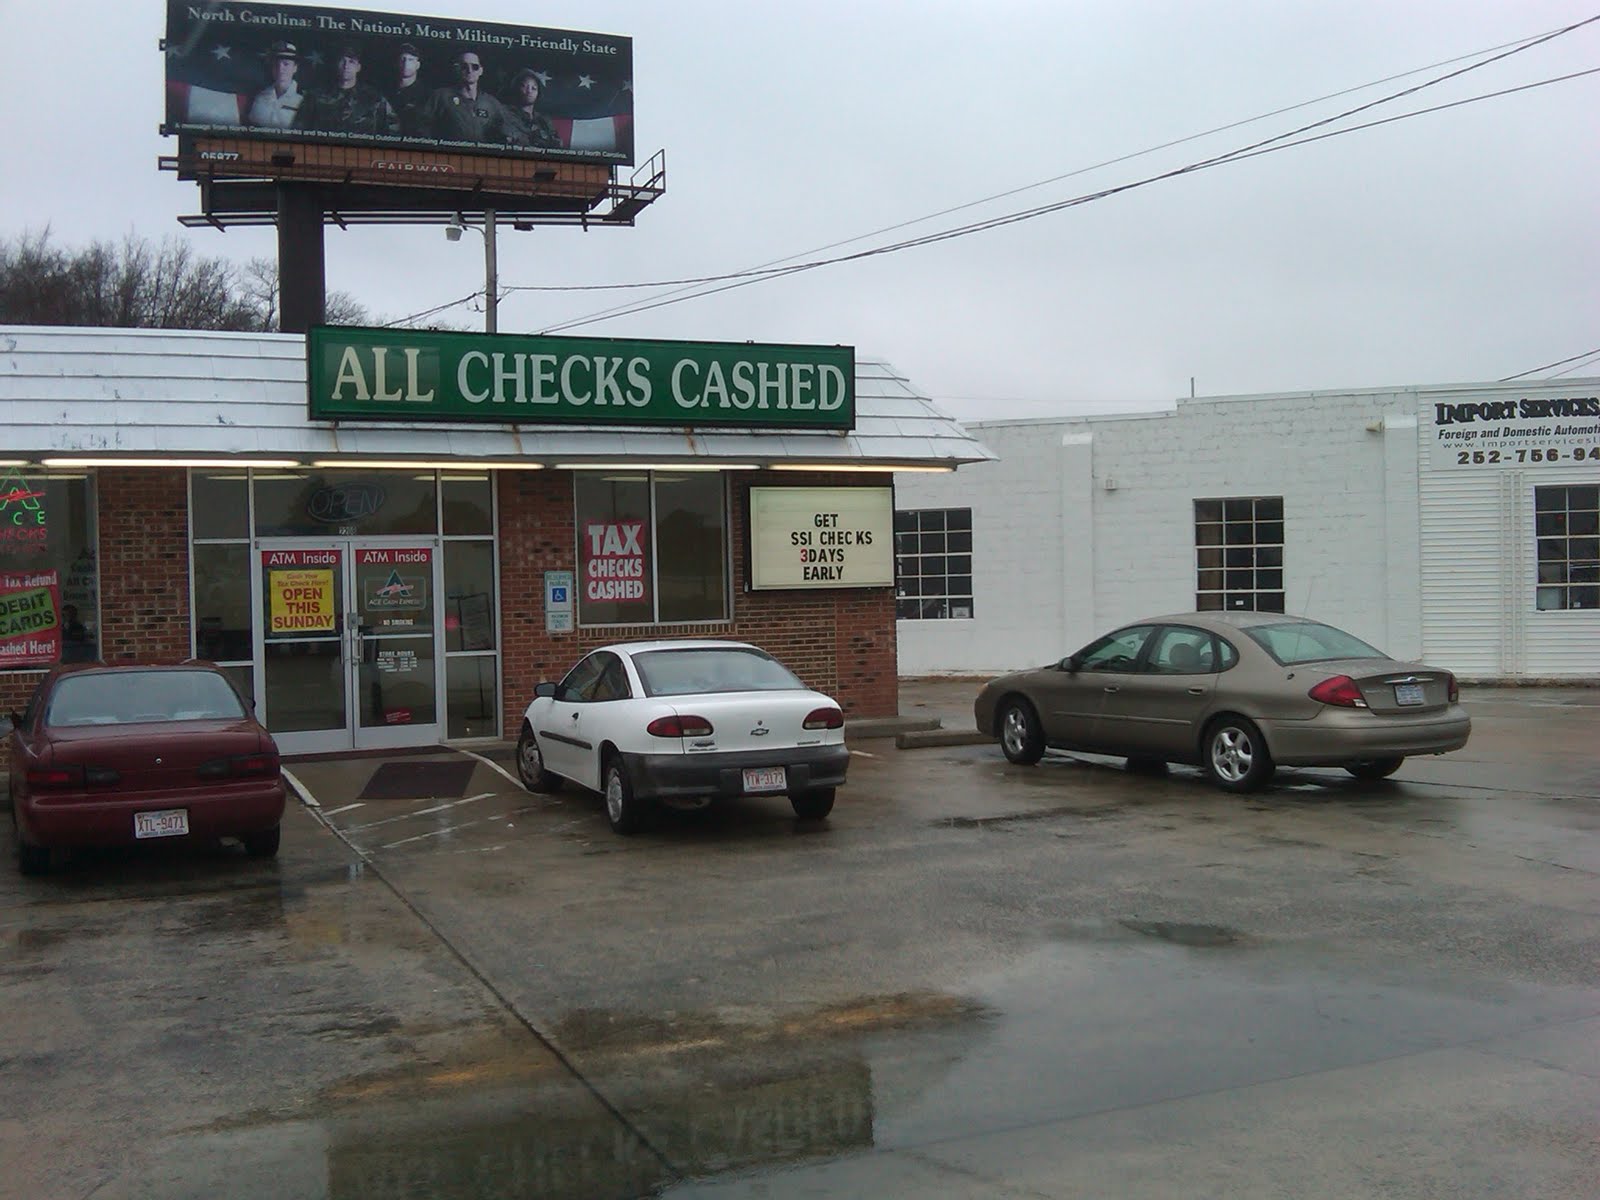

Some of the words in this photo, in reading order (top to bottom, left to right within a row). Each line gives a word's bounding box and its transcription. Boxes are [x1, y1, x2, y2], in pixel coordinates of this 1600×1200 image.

[188, 7, 235, 22] North
[240, 10, 312, 27] Carolina:
[317, 16, 346, 30] The
[351, 18, 411, 35] Nation's
[416, 24, 452, 39] Most
[457, 28, 579, 55] Military-Friendly
[583, 40, 617, 55] State
[248, 126, 281, 134] Carolina's
[348, 132, 374, 140] Carolina
[375, 134, 401, 142] Outdoor
[402, 136, 438, 146] Advertising
[477, 141, 505, 151] Investing
[524, 145, 546, 154] military
[547, 148, 576, 156] resources
[331, 346, 435, 402] ALL
[457, 350, 652, 407] CHECKS
[671, 358, 846, 410] CASHED
[1435, 400, 1518, 426] IMPORT
[1520, 397, 1600, 420] SERVICES
[1438, 428, 1478, 441] Foreign
[1480, 427, 1500, 438] and
[1503, 424, 1551, 438] Domestic
[311, 488, 378, 514] OPEN
[814, 513, 839, 528] GET
[588, 524, 643, 556] TAX
[791, 531, 812, 546] SSI
[819, 531, 873, 545] CHECKS
[269, 552, 296, 565] ATM
[303, 551, 337, 565] Inside
[363, 551, 389, 563] ATM
[395, 550, 427, 563] Inside
[588, 558, 643, 578] CHECKS
[803, 566, 844, 581] EARLY
[4, 575, 21, 588] Tax
[24, 570, 57, 587] Refund
[277, 580, 289, 588] Tax
[282, 587, 323, 601] OPEN
[588, 580, 644, 600] CASHED
[0, 592, 46, 616] DEBIT
[285, 601, 321, 615] THIS
[0, 609, 55, 635] CARDS
[273, 614, 333, 629] SUNDAY
[30, 639, 56, 656] Here!
